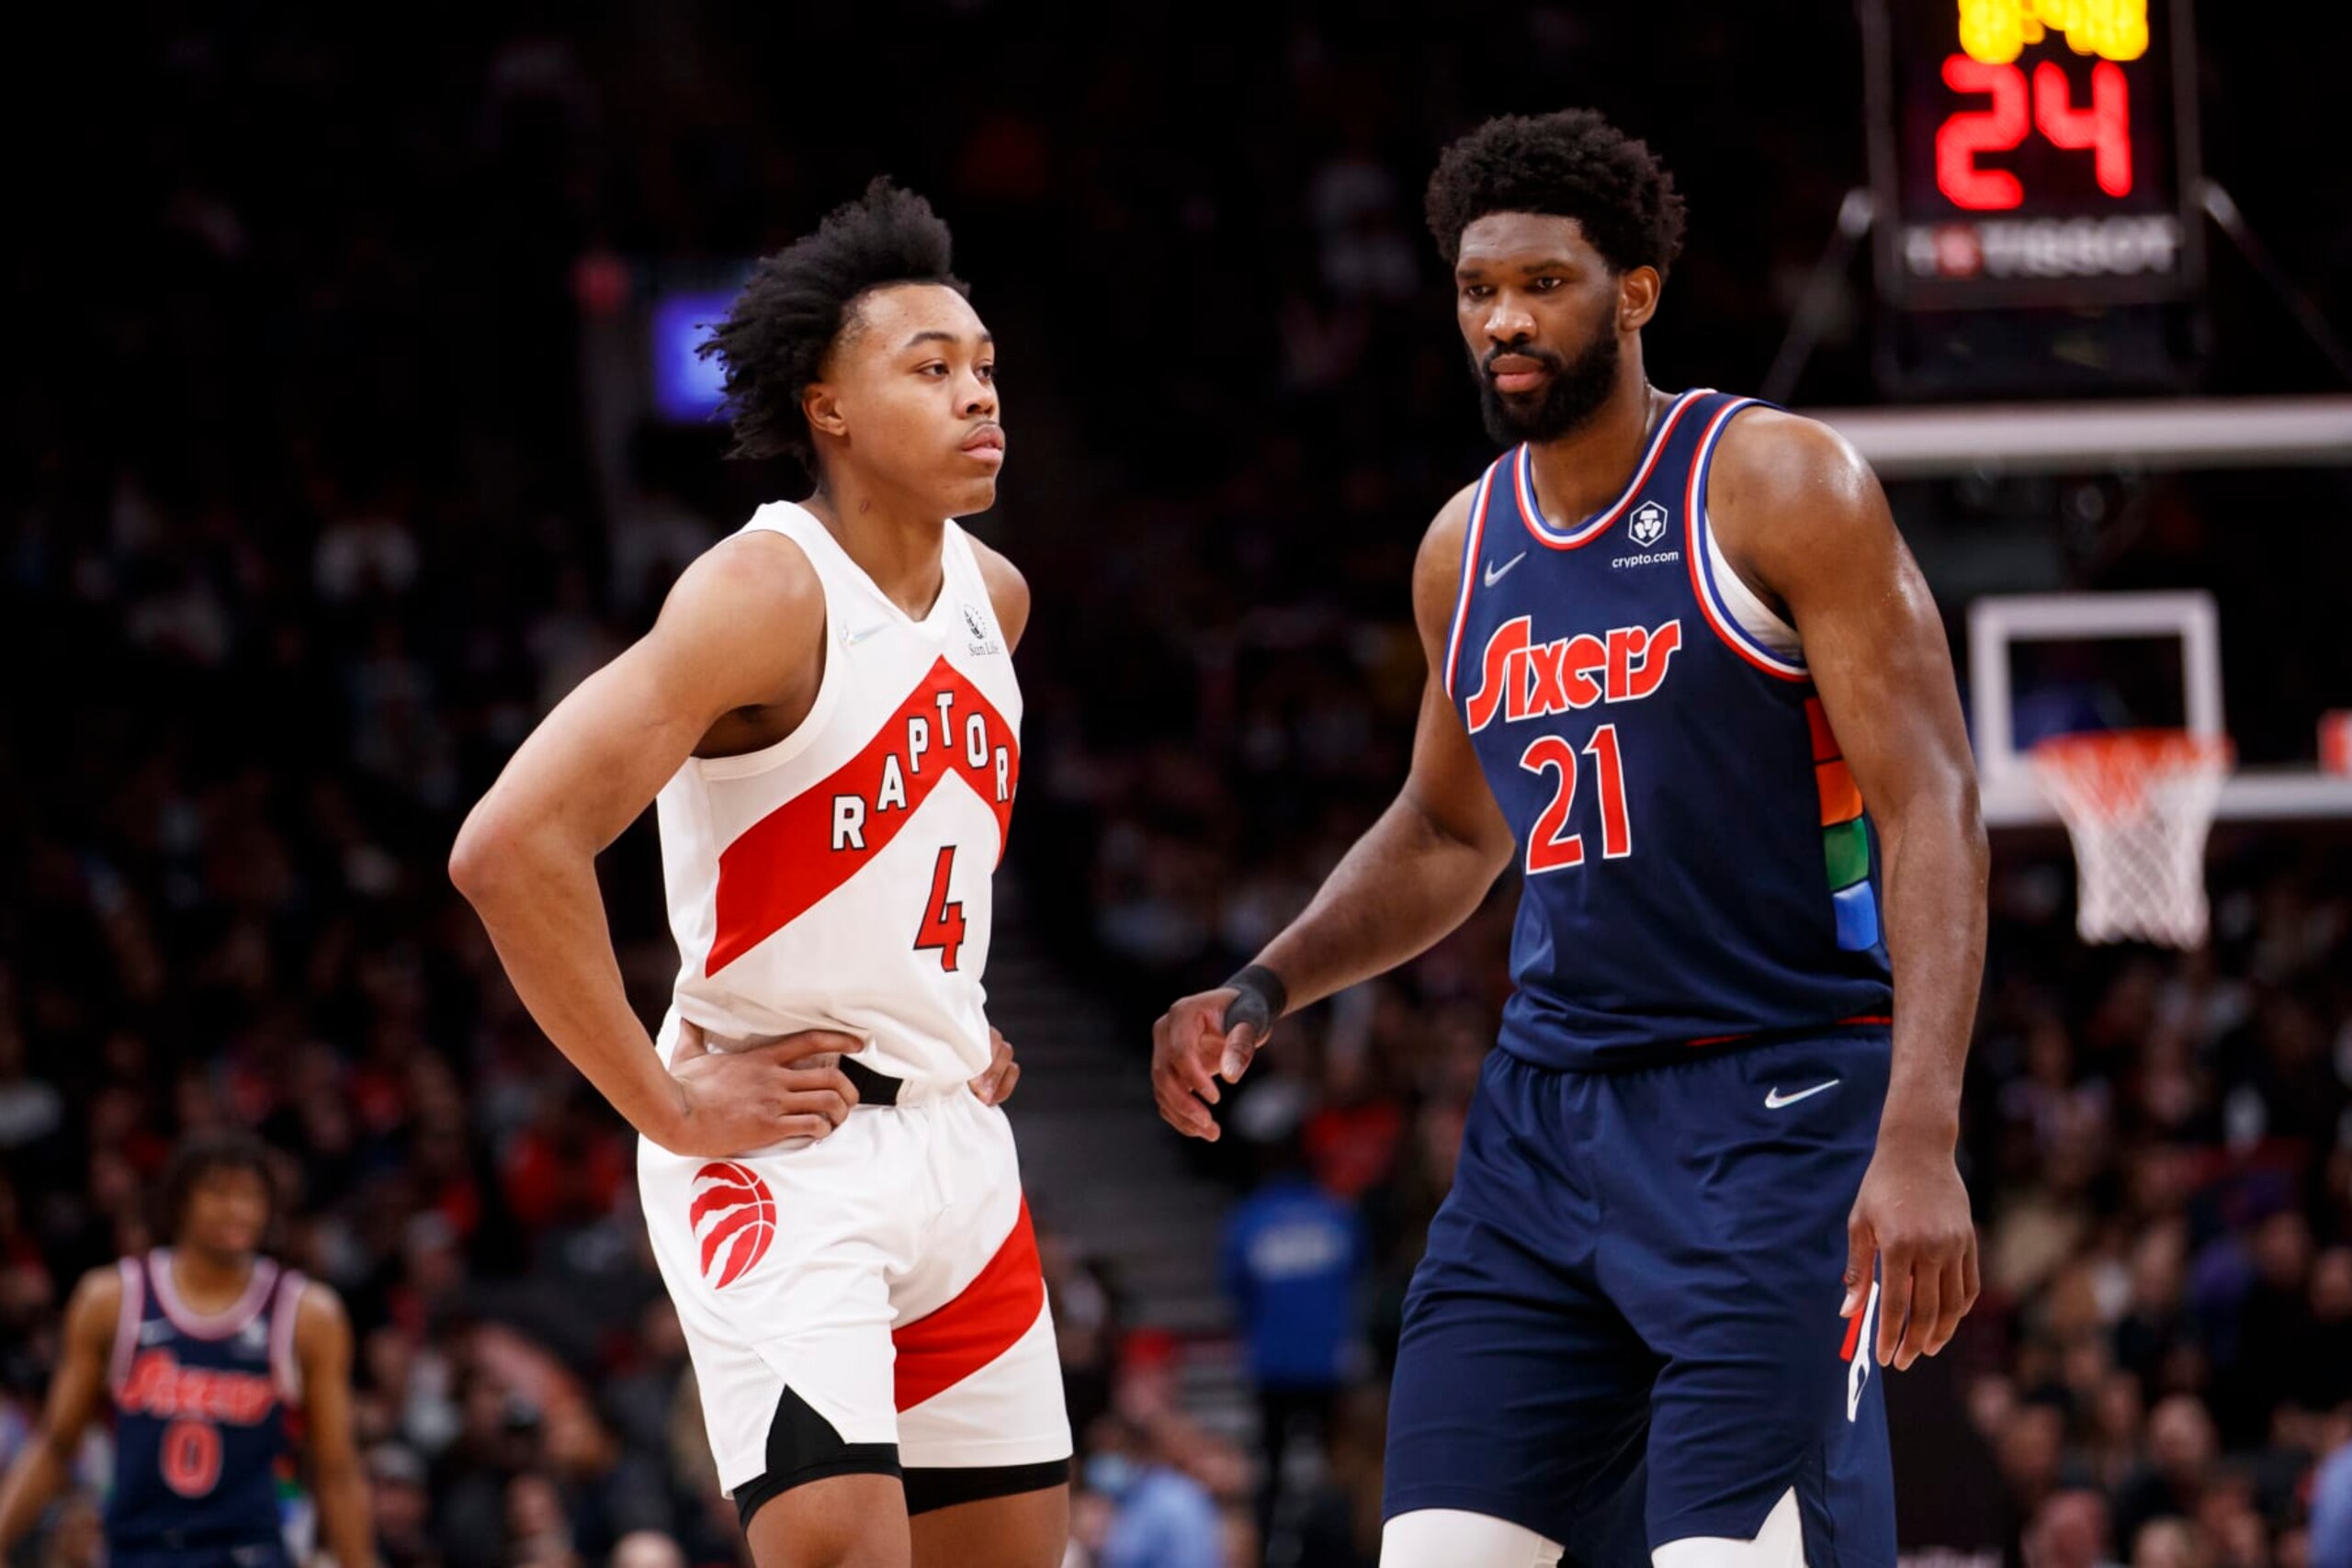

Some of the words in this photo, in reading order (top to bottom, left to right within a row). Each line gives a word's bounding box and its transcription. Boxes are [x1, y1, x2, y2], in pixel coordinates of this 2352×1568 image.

[1937, 53, 2132, 210] 24
[1611, 551, 1679, 569] crypto.com
[1466, 615, 1681, 734] Sixers
[1519, 723, 1631, 874] 21
[913, 845, 967, 973] 4
[162, 1420, 221, 1497] 0
